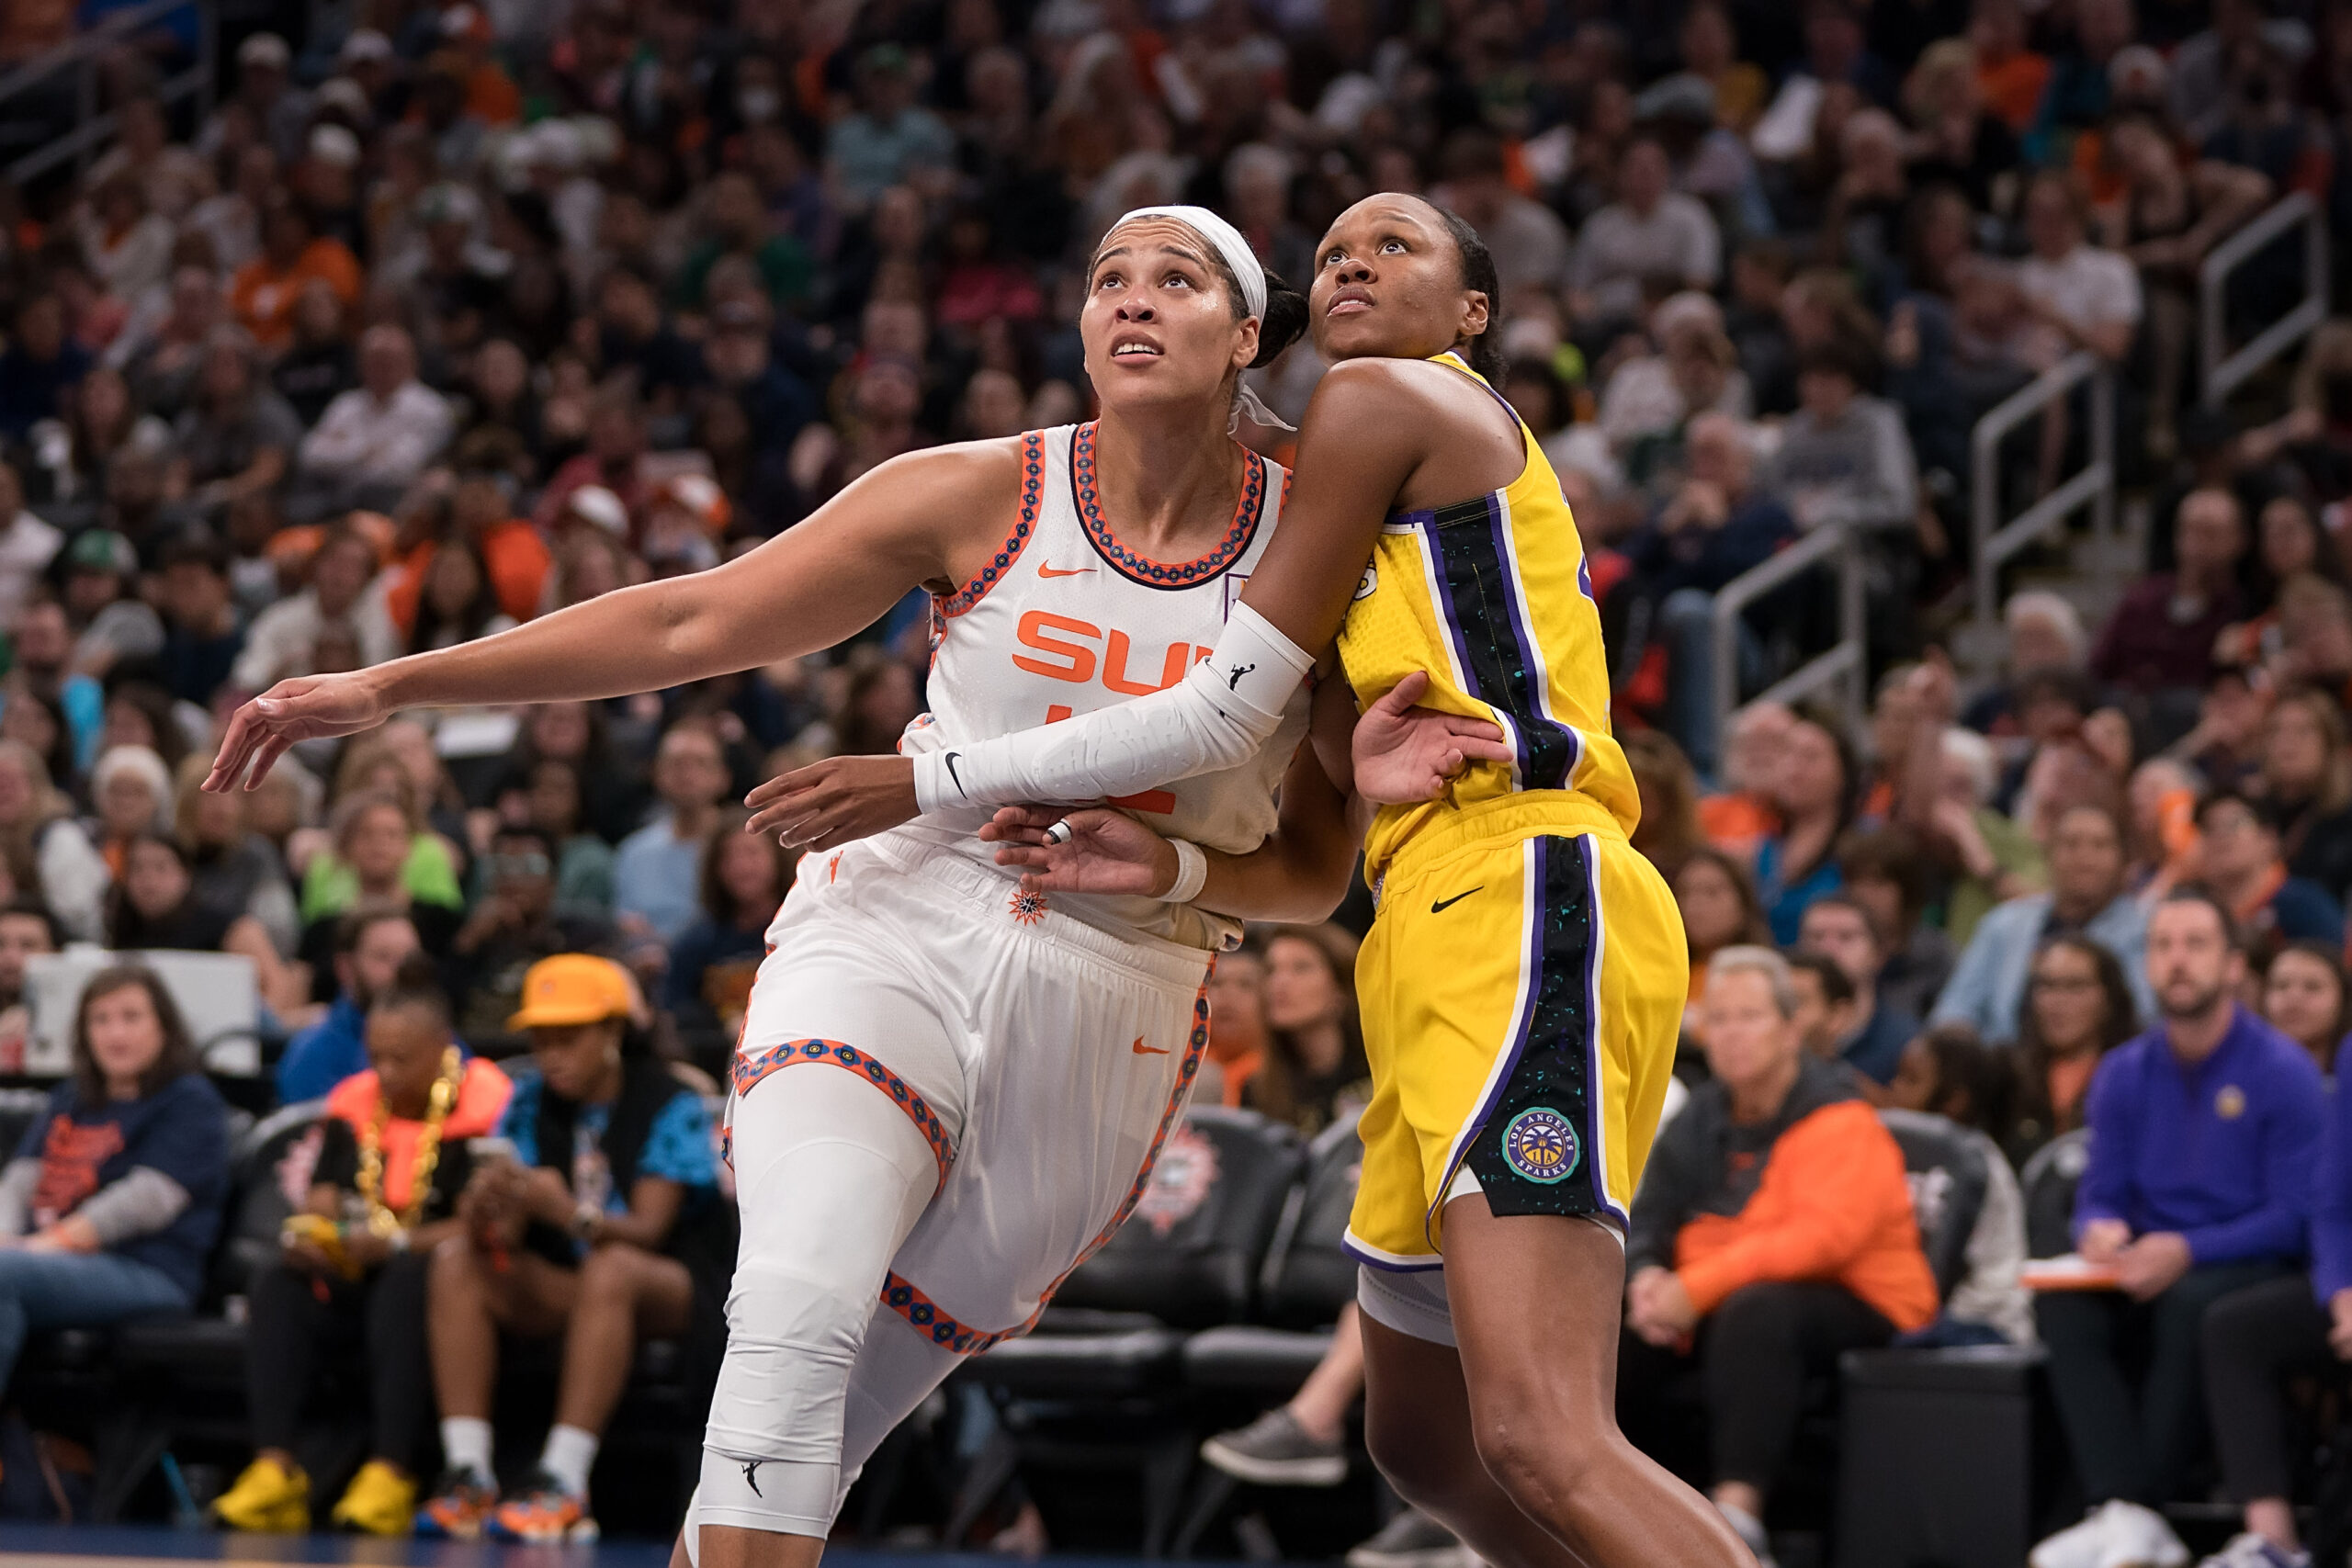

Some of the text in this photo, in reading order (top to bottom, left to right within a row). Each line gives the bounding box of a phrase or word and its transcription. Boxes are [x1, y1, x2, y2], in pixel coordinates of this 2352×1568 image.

[1012, 610, 1214, 696] SU
[1510, 1113, 1574, 1151] LOS ANGELES
[1518, 1159, 1566, 1177] SPARKS
